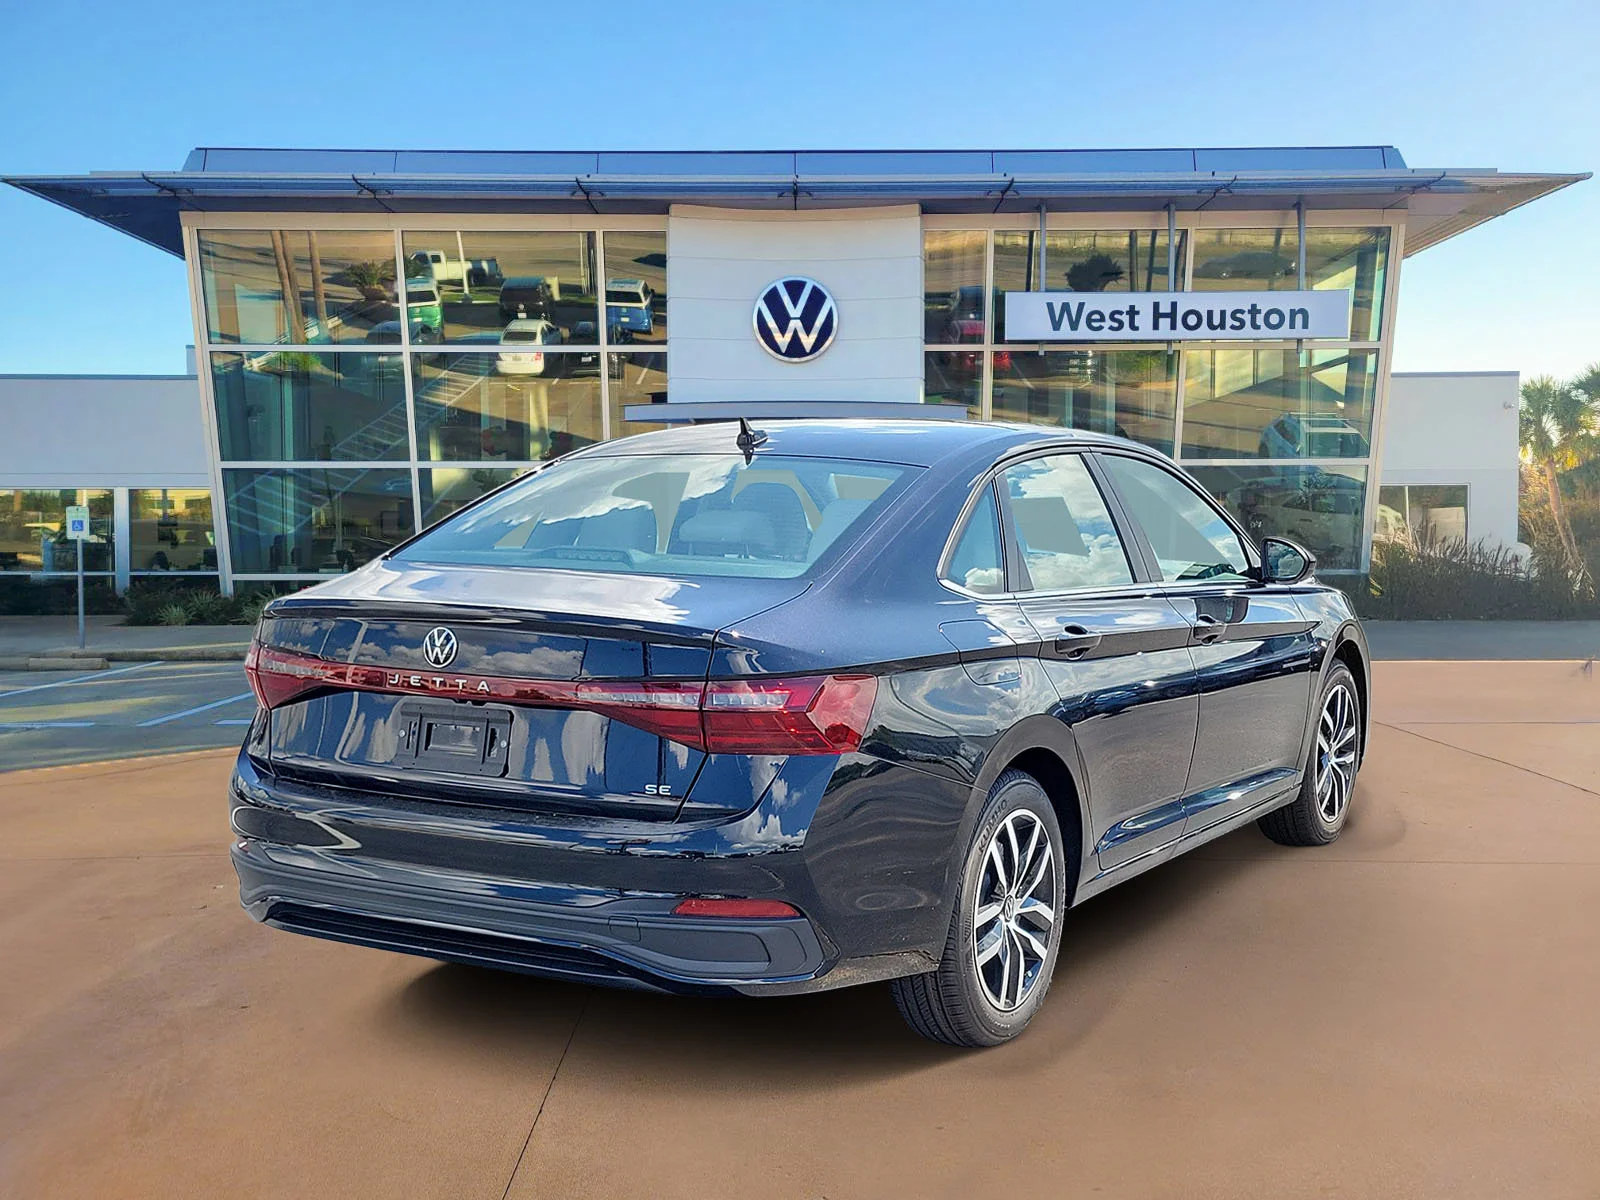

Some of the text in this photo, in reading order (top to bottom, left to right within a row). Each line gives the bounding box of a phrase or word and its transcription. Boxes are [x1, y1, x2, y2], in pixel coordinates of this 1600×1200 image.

[756, 278, 835, 355] VW
[1046, 300, 1310, 332] West Houston
[424, 627, 458, 665] VW
[389, 673, 491, 692] JETTA
[644, 784, 672, 796] SE
